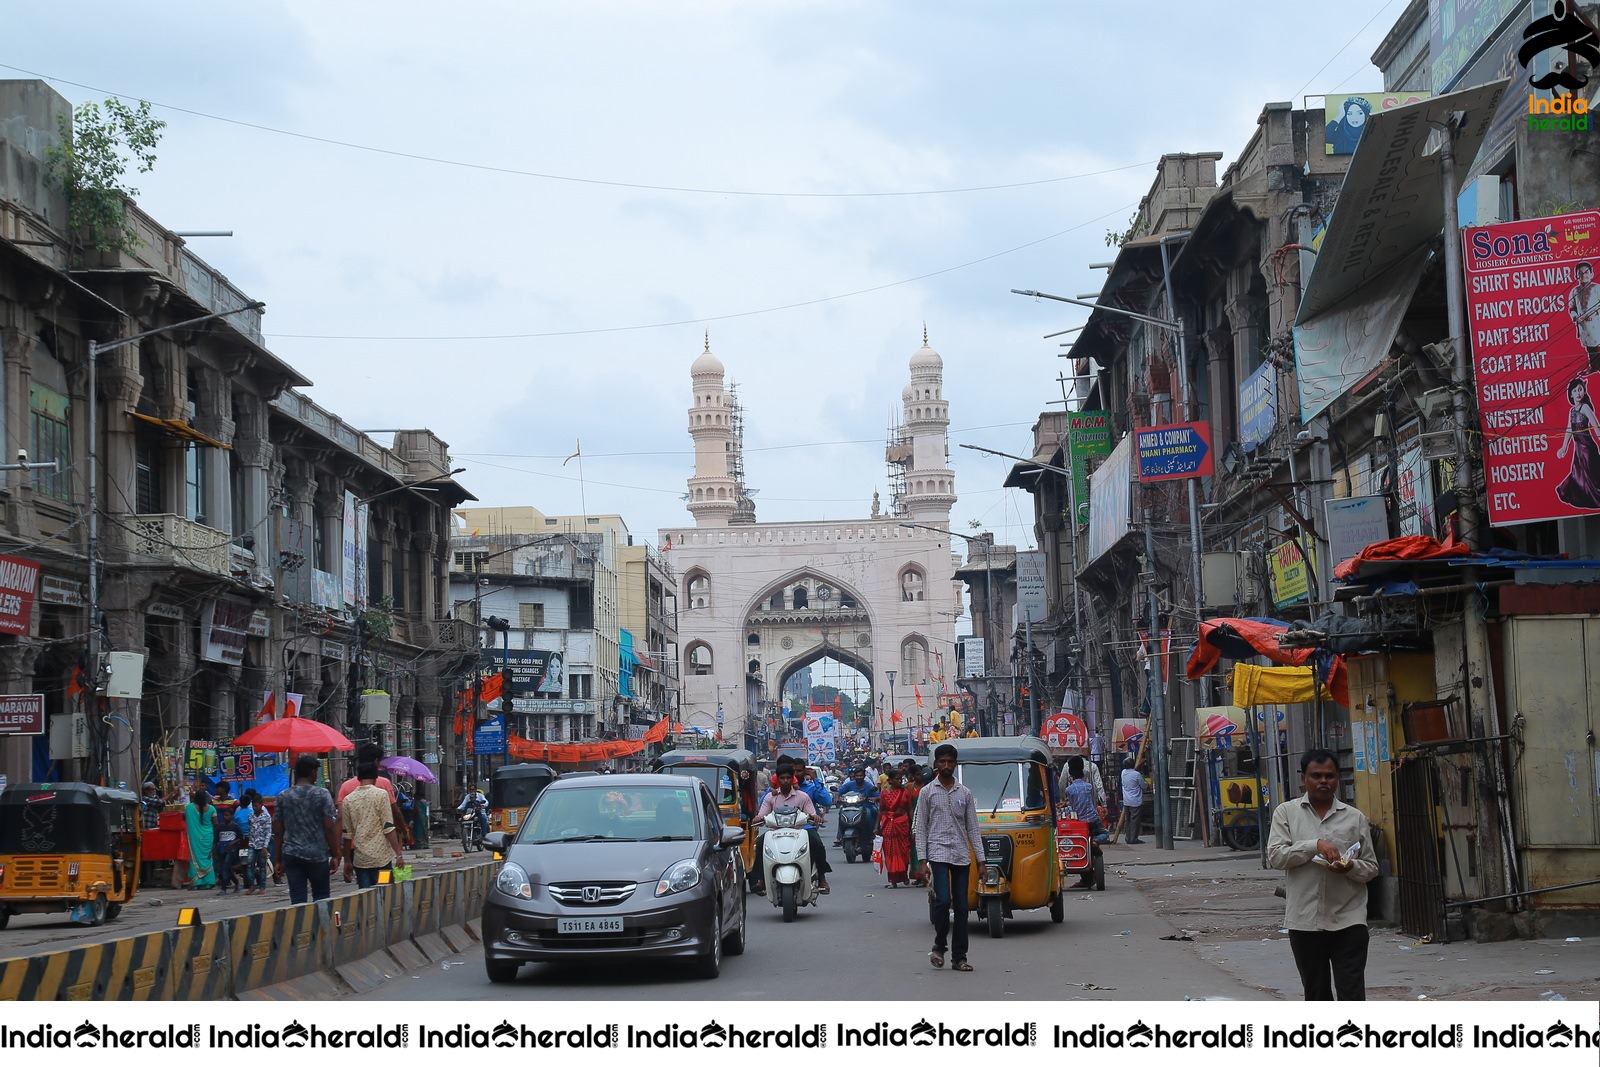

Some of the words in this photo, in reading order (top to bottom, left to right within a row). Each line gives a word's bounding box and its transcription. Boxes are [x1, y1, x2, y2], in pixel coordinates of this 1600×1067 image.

[1368, 110, 1421, 205] WHOLESALE
[1343, 221, 1376, 273] RETAIL
[1472, 230, 1552, 260] Sona
[1476, 258, 1508, 268] HOSIERY
[1511, 254, 1553, 265] GARMENTS
[1472, 274, 1509, 293] SHIRT
[1513, 266, 1573, 289] SHALWAR
[1475, 300, 1513, 320] FANCY
[1517, 294, 1565, 316] FROCKS
[1478, 328, 1509, 347] PANT
[1513, 324, 1549, 344] SHIRT
[1480, 356, 1512, 374] COAT
[1515, 352, 1547, 371] PANT
[1483, 379, 1550, 401] SHERWANI
[1485, 407, 1544, 429] WESTERN
[1140, 432, 1158, 448] AHMED
[1159, 432, 1163, 446] &
[1165, 429, 1190, 445] COMPANY
[1488, 434, 1548, 456] NIGHTIES
[1141, 448, 1160, 458] UNANI
[1162, 445, 1197, 455] PHARMACY
[1491, 462, 1545, 483] HOSIERY
[1494, 492, 1520, 511] ETC.
[563, 923, 581, 931] TS11
[584, 922, 595, 930] EA
[598, 921, 620, 930] 4845
